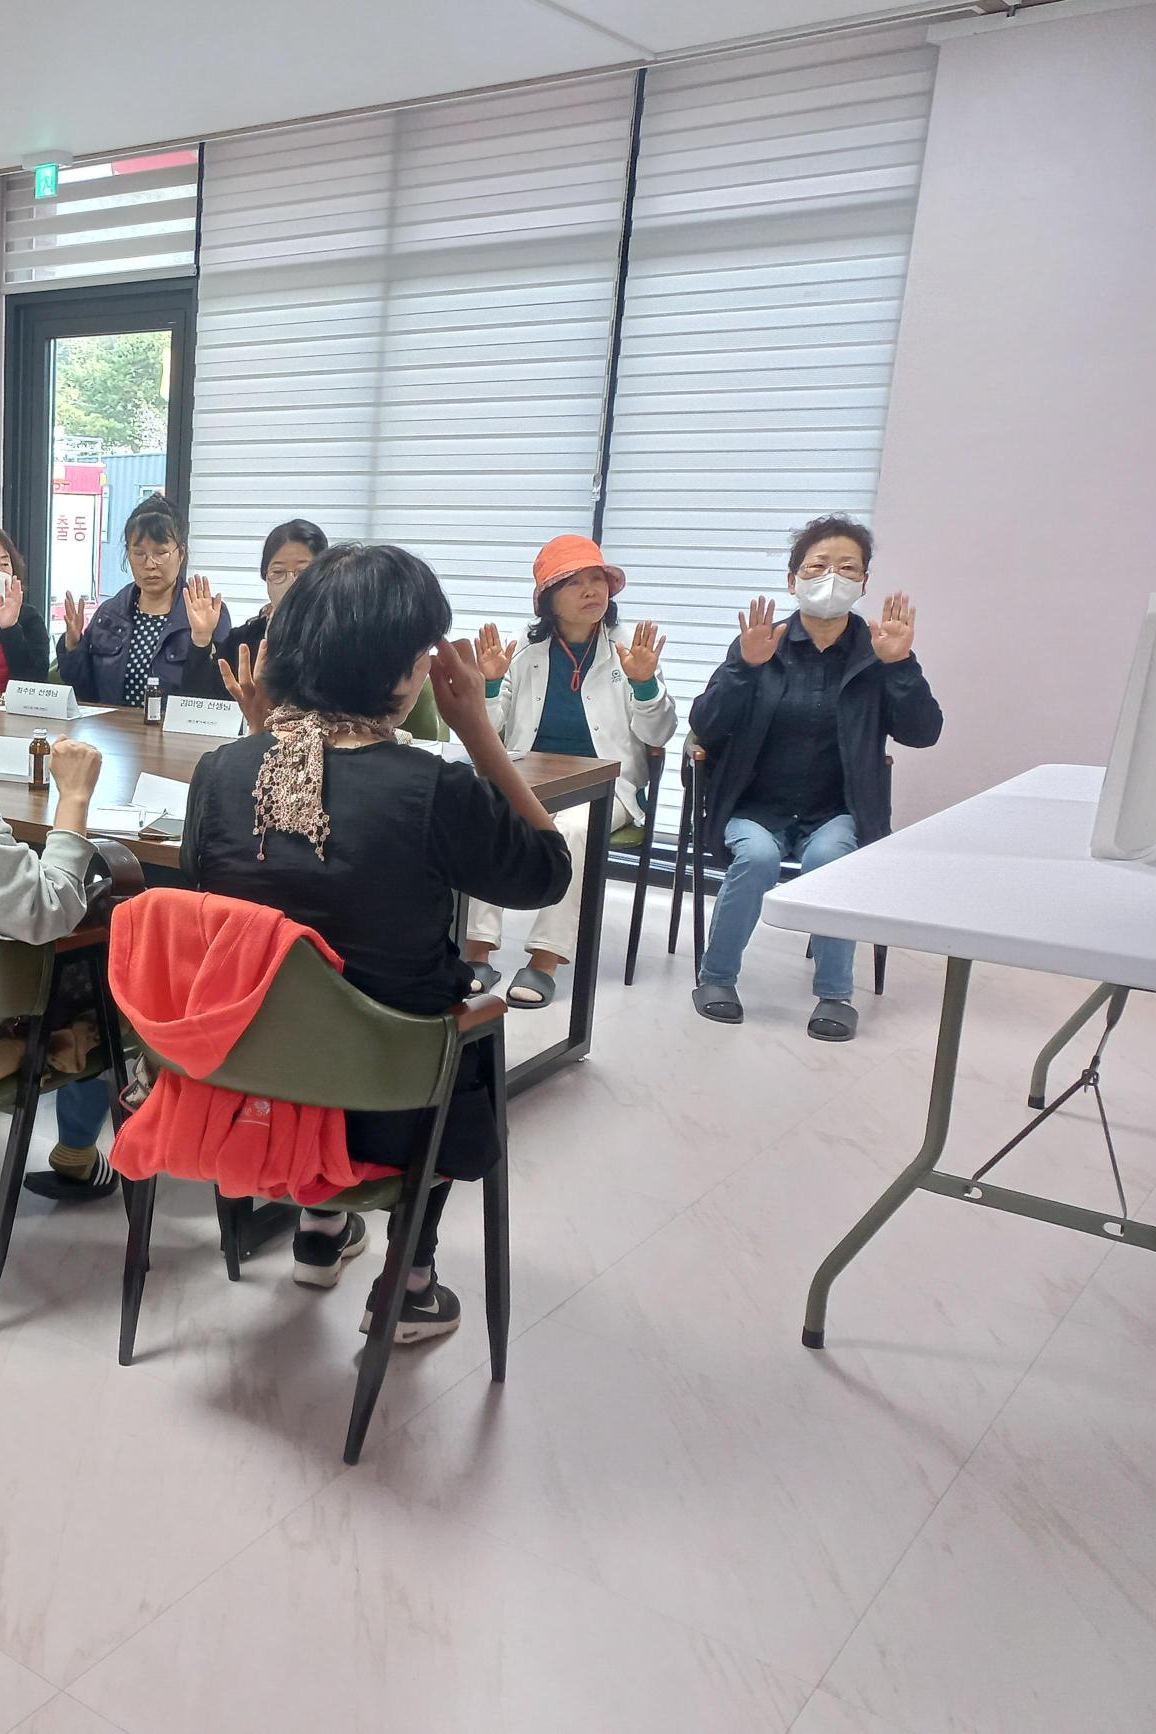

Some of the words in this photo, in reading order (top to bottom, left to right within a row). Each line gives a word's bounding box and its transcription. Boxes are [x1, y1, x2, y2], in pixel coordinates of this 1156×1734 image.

[56, 515, 87, 541] 출동
[38, 688, 58, 697] 선생님
[207, 701, 231, 711] 선생님
